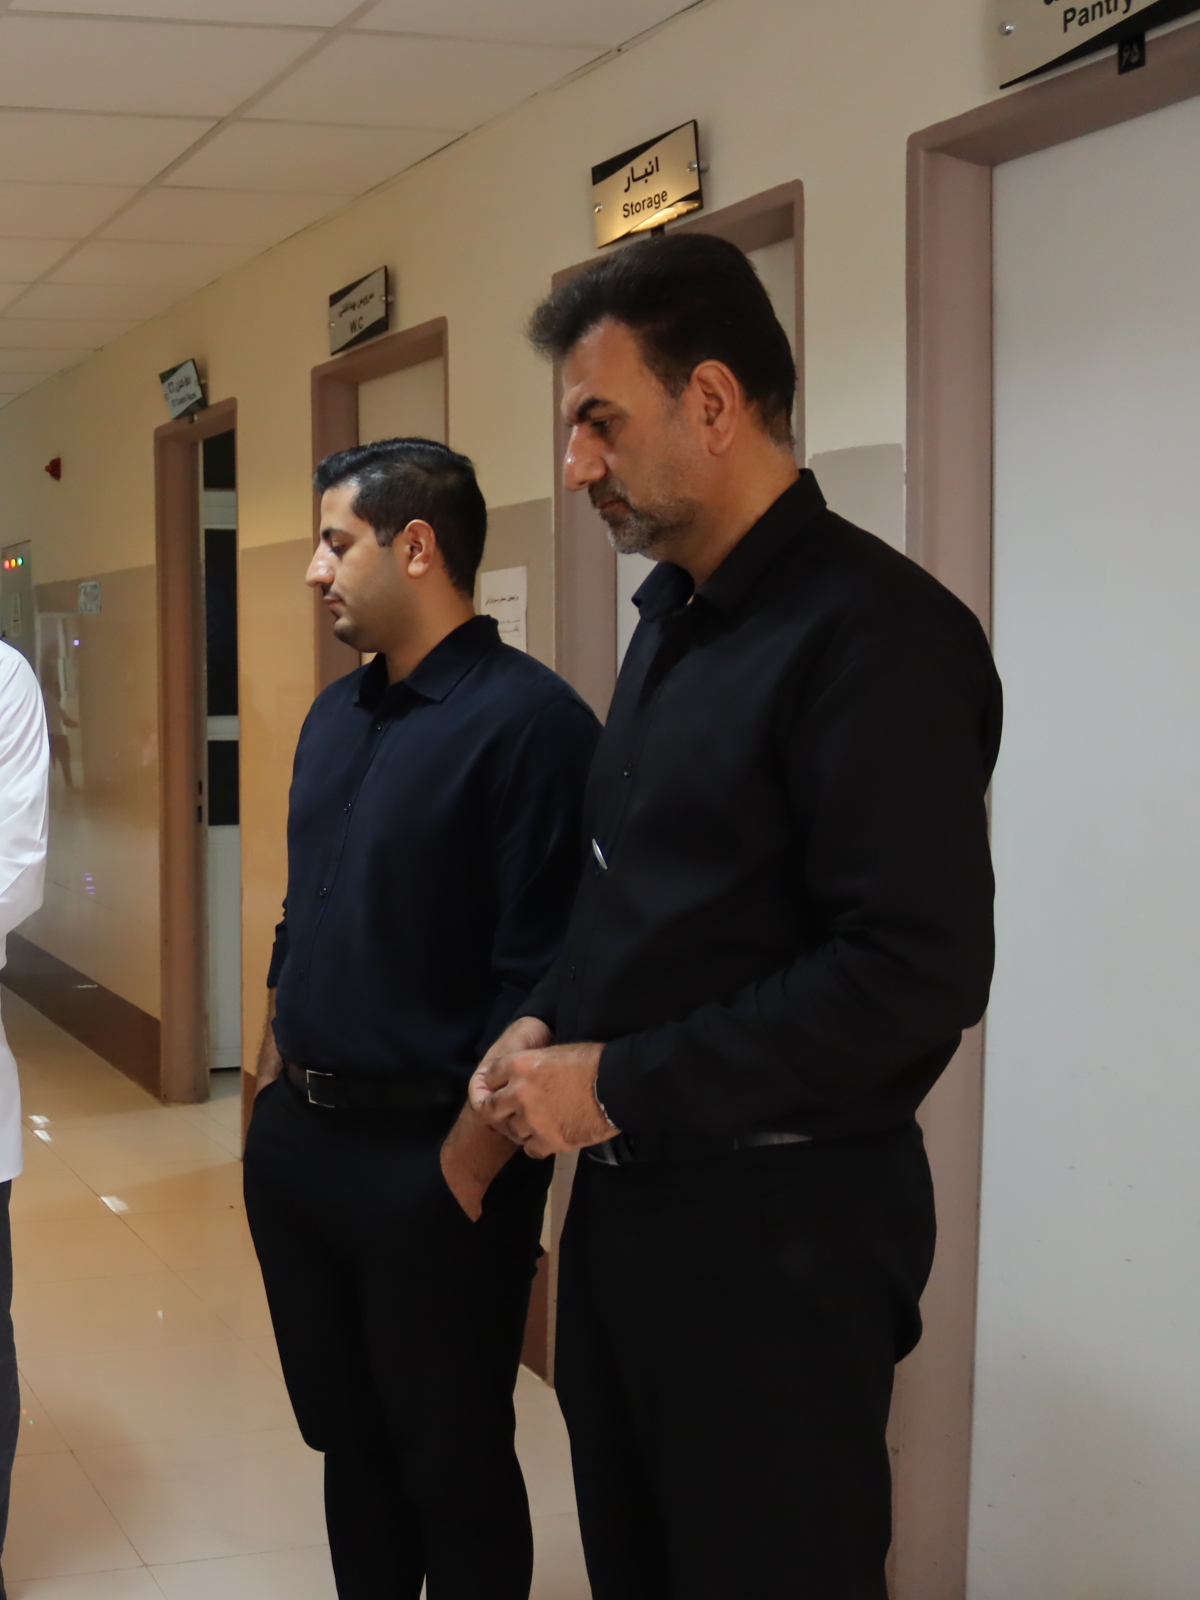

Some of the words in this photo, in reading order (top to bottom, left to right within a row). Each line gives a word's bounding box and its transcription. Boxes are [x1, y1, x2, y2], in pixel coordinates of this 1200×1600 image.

[1063, 0, 1132, 33] Pantry
[623, 156, 659, 193] انبار
[622, 190, 668, 218] Storage
